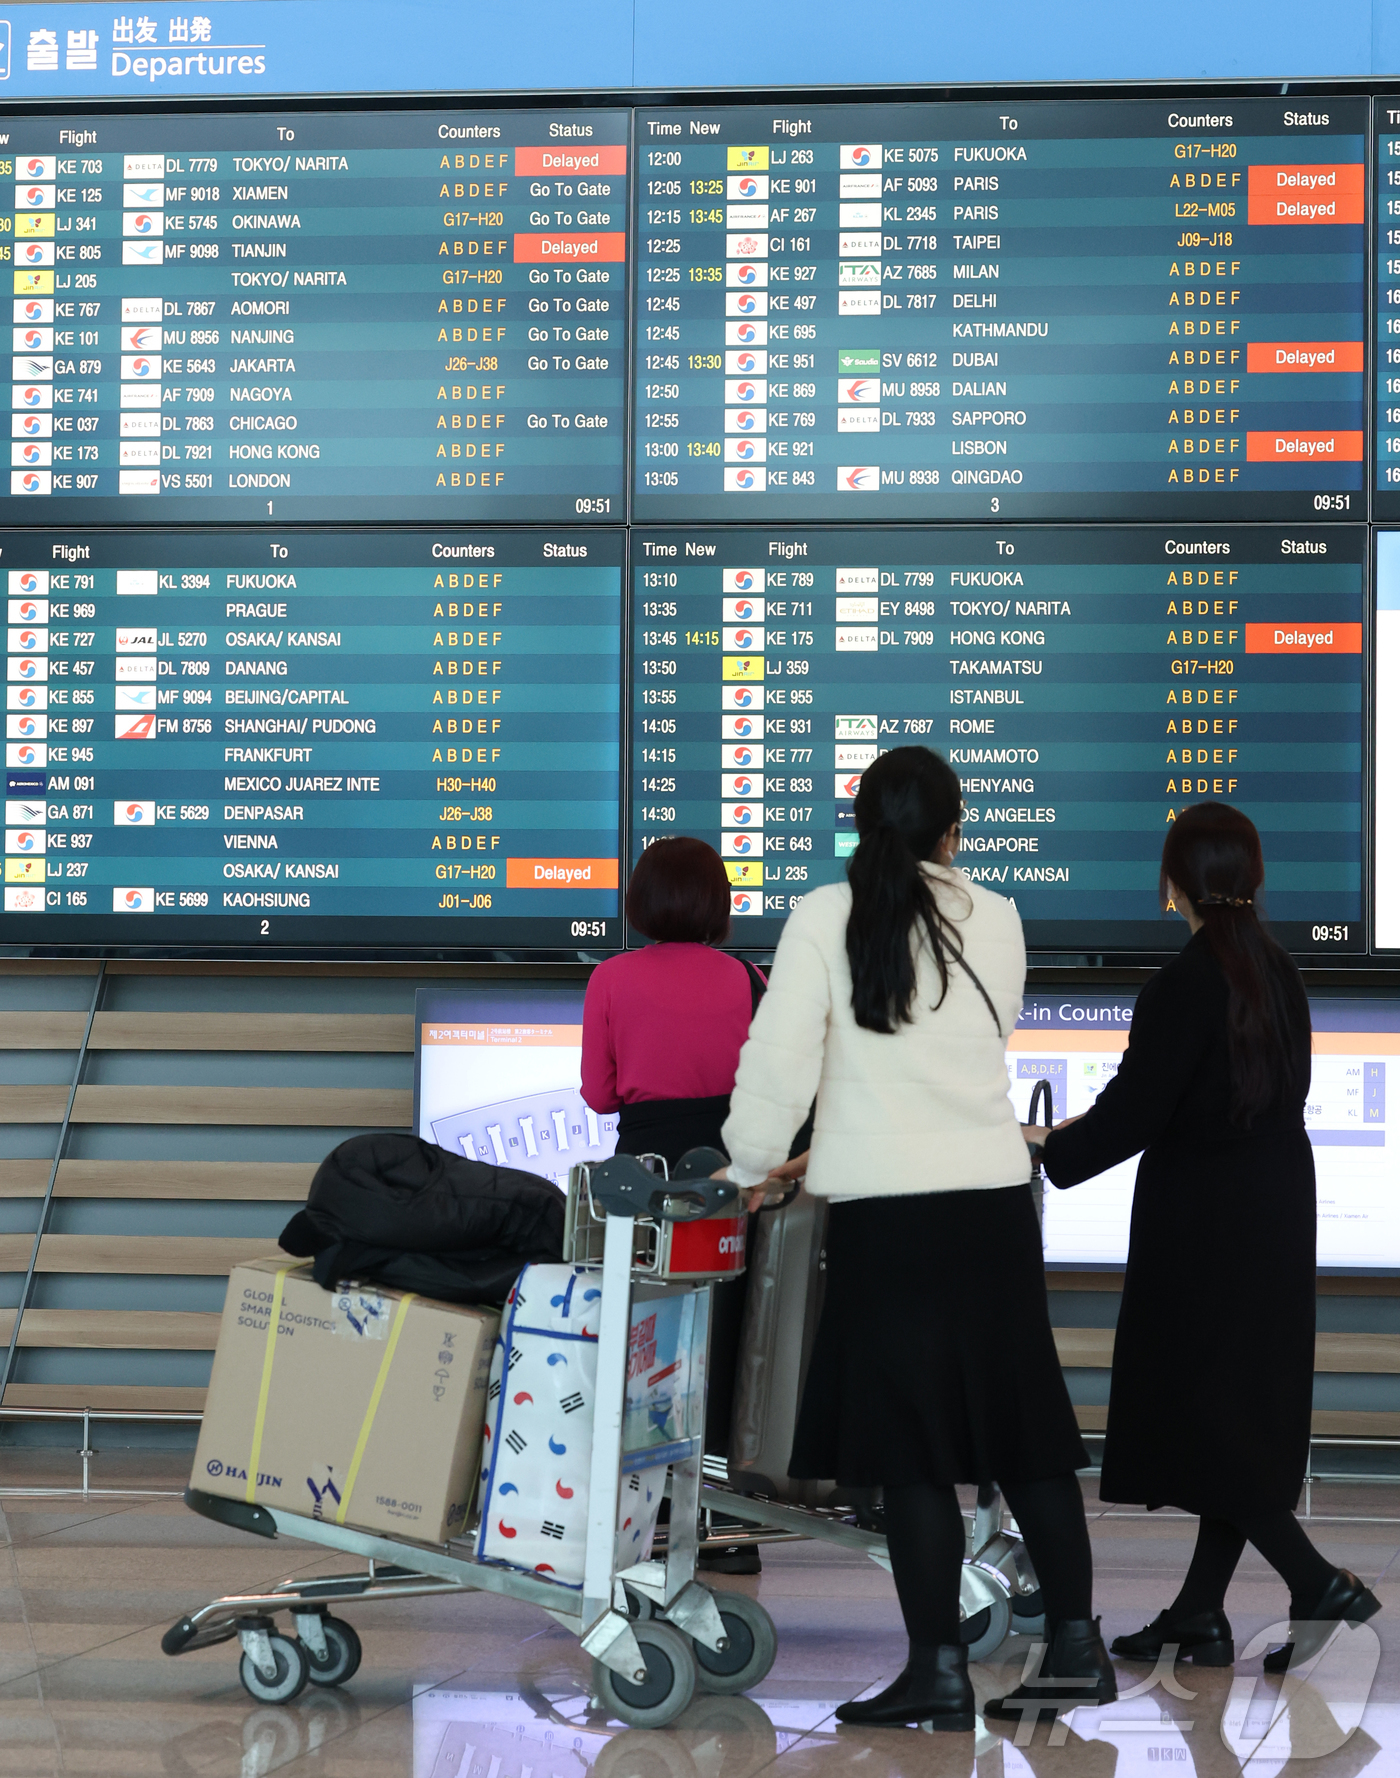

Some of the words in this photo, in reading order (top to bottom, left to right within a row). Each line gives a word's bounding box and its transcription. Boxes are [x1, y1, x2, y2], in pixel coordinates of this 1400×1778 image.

[112, 15, 158, 44] 出发
[168, 15, 212, 43] 出発
[26, 28, 100, 71] 출발
[111, 52, 266, 83] Departures
[999, 115, 1018, 131] To
[1167, 113, 1234, 128] Counters
[1283, 111, 1330, 126] Status
[276, 126, 295, 141] To
[437, 124, 501, 139] Counters
[548, 122, 594, 138] Status
[646, 121, 682, 136] Time
[689, 120, 721, 135] New
[772, 119, 812, 137] Flight
[59, 129, 98, 148] Flight
[647, 151, 682, 166] 12:00
[954, 146, 1028, 162] FUKUOKA
[1174, 143, 1237, 159] G17-H20
[232, 155, 292, 173] TOKYO/
[295, 156, 349, 171] NARITA
[542, 152, 599, 171] Delayed
[647, 180, 682, 195] 12:05
[689, 179, 724, 195] 13:25
[953, 176, 999, 191] PARIS
[1276, 171, 1336, 190] Delayed
[57, 188, 77, 203] KE
[80, 187, 103, 203] 125
[165, 187, 187, 202] MF
[190, 186, 220, 202] 9018
[232, 185, 288, 201] XIAMEN
[529, 182, 551, 197] Go
[554, 182, 573, 197] To
[577, 181, 611, 197] Gate
[953, 205, 999, 221] PARIS
[1175, 202, 1236, 218] L22-M05
[1276, 200, 1336, 220] Delayed
[231, 214, 302, 230] OKINAWA
[443, 211, 504, 227] G17-H20
[952, 234, 1001, 250] TAIPEI
[1176, 231, 1233, 247] J09-J18
[231, 243, 287, 258] TIANJIN
[541, 239, 598, 258] Delayed
[230, 270, 290, 288] TOKYO/
[293, 271, 348, 286] NARITA
[442, 269, 503, 285] G17-H20
[953, 264, 1000, 279] MILAN
[230, 300, 290, 316] AOMORI
[953, 293, 997, 309] DELHI
[230, 329, 295, 344] NANJING
[952, 322, 1049, 338] KATHMANDU
[229, 358, 296, 373] JAKARTA
[444, 356, 499, 372] J26-J38
[952, 352, 999, 367] DUBAI
[1275, 349, 1335, 368] Delayed
[230, 386, 293, 402] NAGOYA
[952, 381, 1007, 397] DALIAN
[229, 415, 298, 431] CHICAGO
[951, 410, 1027, 426] SAPPORO
[229, 444, 273, 460] HONG
[277, 444, 320, 459] KONG
[951, 440, 1007, 456] LISBON
[1275, 437, 1335, 457] Delayed
[228, 473, 291, 489] LONDON
[951, 469, 1023, 485] QINGDAO
[266, 500, 273, 516] 1
[575, 498, 610, 514] 09:51
[990, 497, 1000, 513] 3
[1313, 494, 1350, 511] 09:51
[52, 544, 91, 563] Flight
[269, 543, 289, 559] To
[431, 542, 495, 558] Counters
[543, 542, 588, 558] Status
[642, 542, 678, 557] Time
[685, 542, 717, 557] New
[768, 541, 808, 560] Flight
[995, 540, 1015, 556] To
[1164, 539, 1231, 555] Counters
[1280, 539, 1327, 554] Status
[226, 573, 297, 589] FUKUOKA
[643, 572, 678, 588] 13:10
[950, 571, 1024, 587] FUKUOKA
[226, 602, 288, 618] PRAGUE
[949, 599, 1011, 618] TOKYO/
[1015, 601, 1072, 616] NARITA
[130, 636, 154, 644] JAL
[225, 630, 284, 648] OSAKA/
[287, 631, 341, 647] KANSAI
[642, 631, 677, 646] 13:45
[685, 631, 720, 646] 14:15
[950, 630, 996, 646] HONG
[1000, 630, 1045, 646] KONG
[1274, 629, 1334, 648] Delayed
[225, 660, 288, 676] DANANG
[949, 659, 1043, 675] TAKAMATSU
[1170, 659, 1234, 675] G17-H20
[224, 688, 350, 706] BEIJING/CAPITAL
[950, 689, 1025, 705] ISTANBUL
[224, 717, 309, 735] SHANGHAI/
[312, 718, 377, 734] PUDONG
[949, 718, 995, 734] ROME
[224, 747, 313, 763] FRANKFURT
[949, 748, 1039, 764] KUMAMOTO
[47, 776, 70, 791] AM
[73, 776, 95, 791] 091
[224, 776, 282, 792] MEXICO
[285, 776, 343, 792] JUAREZ
[346, 776, 381, 792] INTE
[436, 777, 497, 793] H30-H40
[960, 778, 1035, 793] HENYANG
[224, 805, 304, 821] DENPASAR
[439, 806, 493, 822] J26-J38
[961, 807, 980, 823] OS
[983, 807, 1056, 823] ANGELES
[223, 834, 279, 850] VIENNA
[960, 837, 1040, 853] INGAPORE
[222, 862, 282, 880] OSAKA/
[285, 863, 339, 879] KANSAI
[435, 864, 496, 880] G17-H20
[534, 864, 592, 884] Delayed
[961, 865, 1009, 882] SAKA/
[1013, 866, 1069, 882] KANSAI
[223, 892, 311, 908] KAOHSIUNG
[438, 893, 492, 909] J01-J06
[260, 919, 270, 935] 2
[570, 920, 606, 937] 09:51
[1311, 925, 1348, 941] 09:51
[1018, 1003, 1051, 1021] k-in
[1058, 1004, 1133, 1022] Counte
[1346, 1068, 1360, 1076] AM
[1347, 1109, 1358, 1117] KL
[243, 1288, 287, 1307] GLOBL
[240, 1302, 272, 1317] SMAR
[279, 1311, 336, 1331] LOGISTICS
[237, 1316, 295, 1336] SOLUON
[225, 1466, 283, 1488] HAJIN
[375, 1495, 423, 1513] 1588-0011
